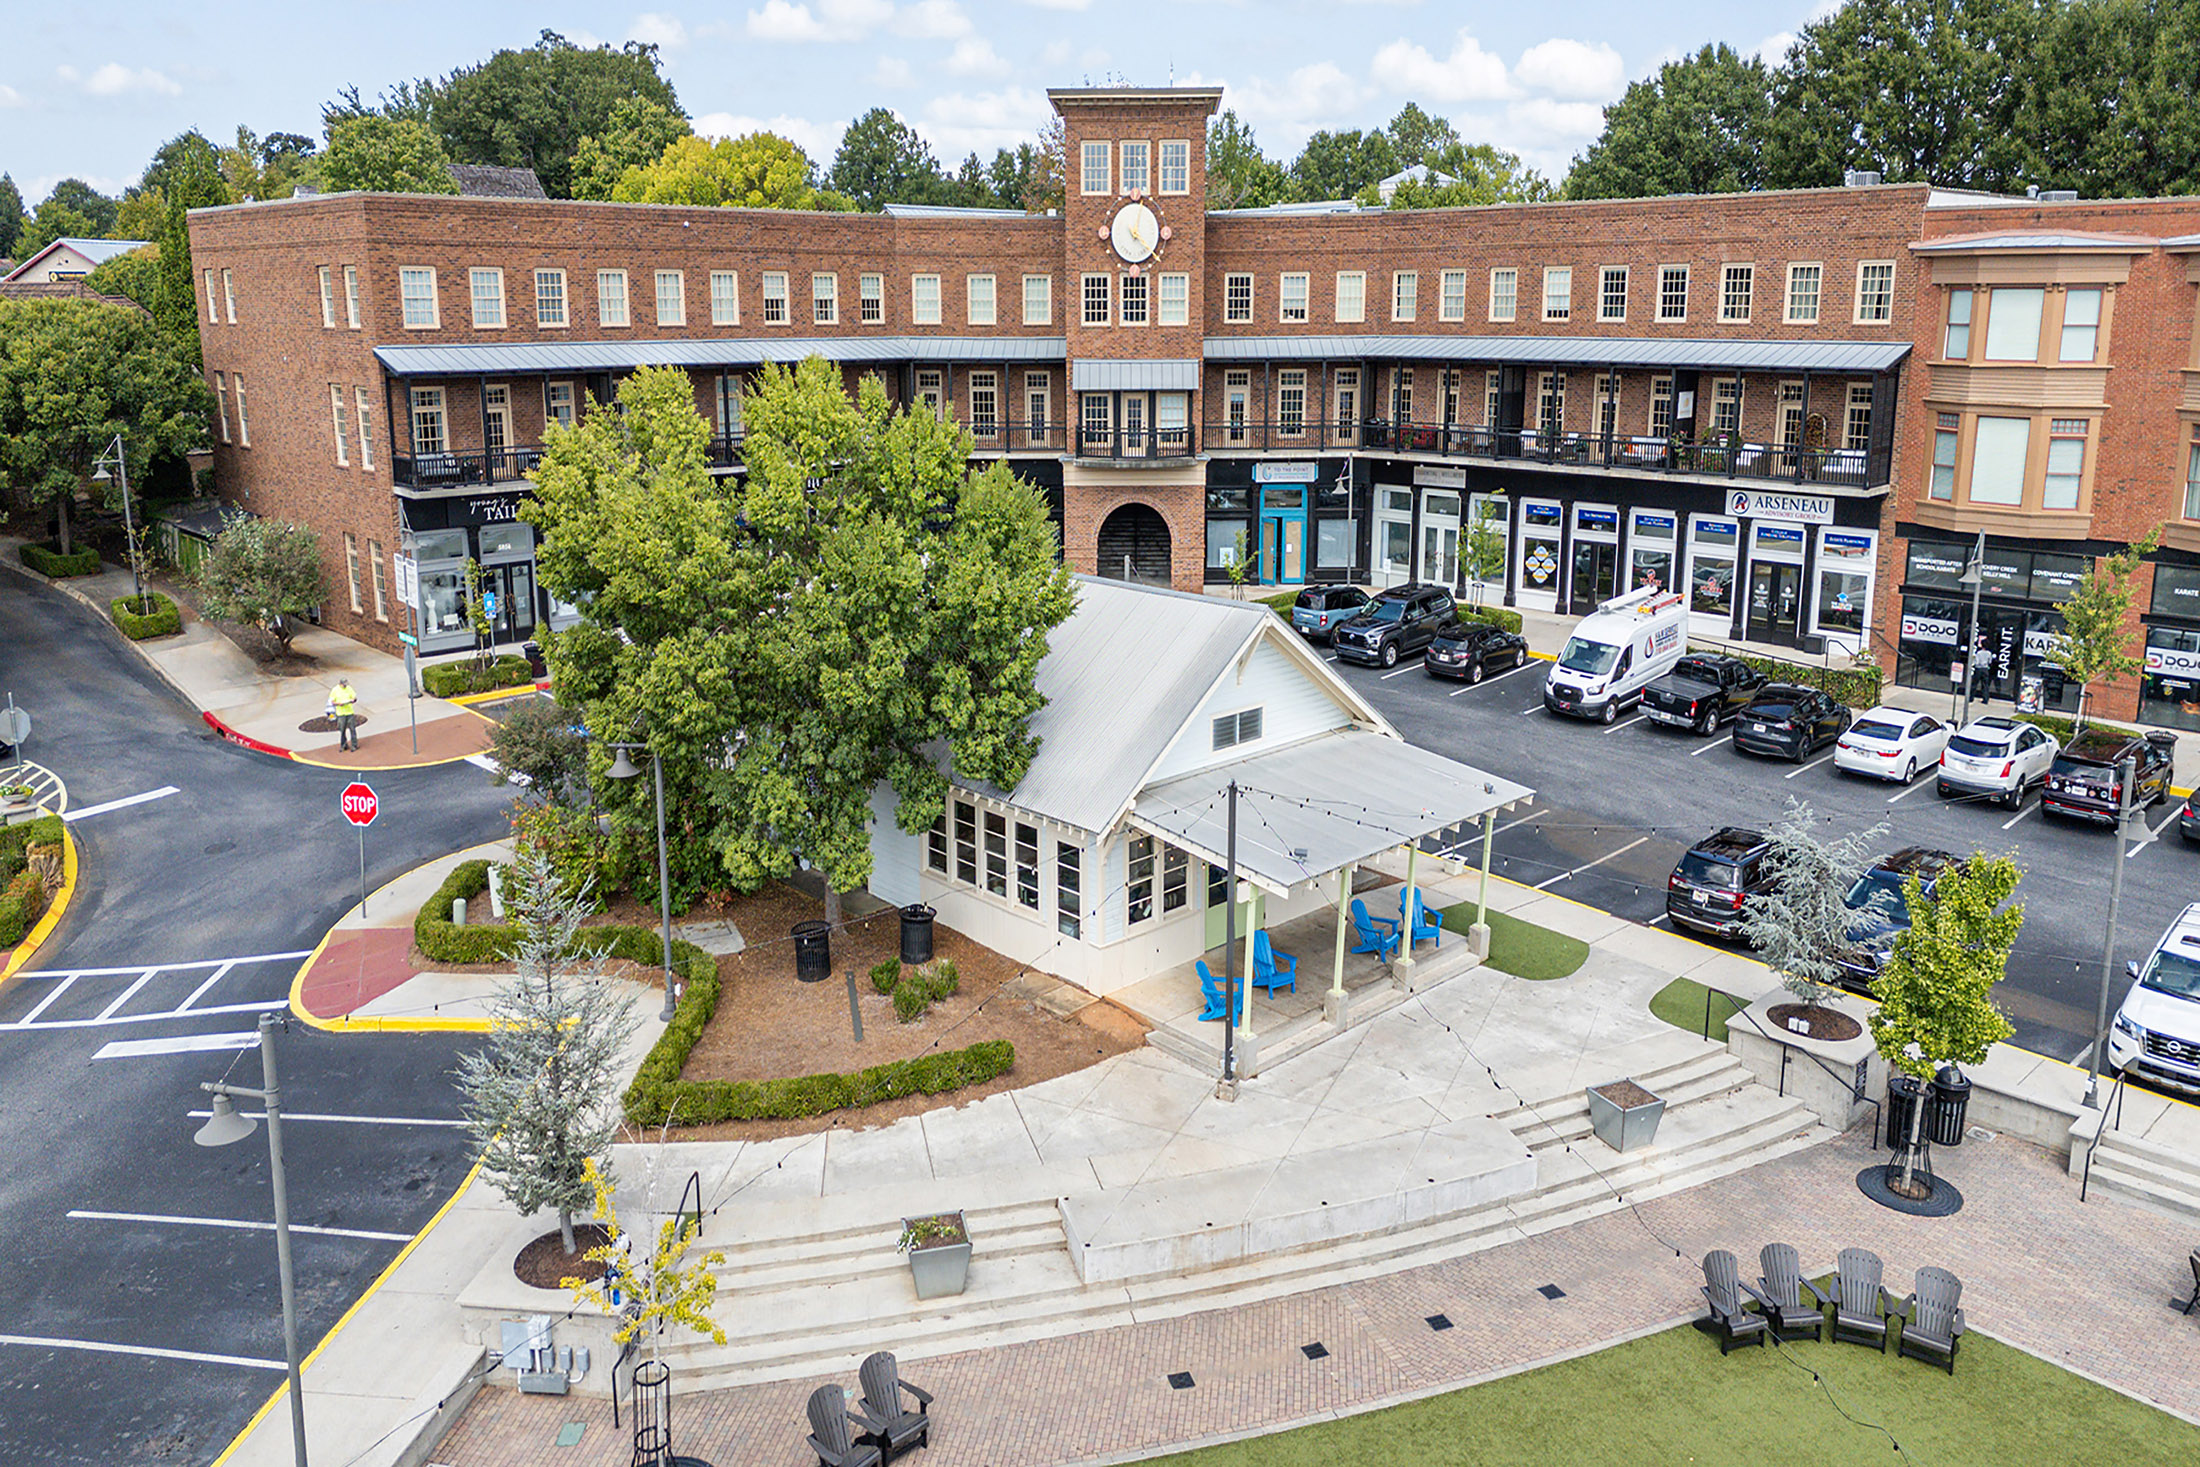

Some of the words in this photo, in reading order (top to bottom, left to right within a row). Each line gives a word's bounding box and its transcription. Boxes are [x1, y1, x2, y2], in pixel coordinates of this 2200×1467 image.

[483, 504, 517, 521] TAIL
[1754, 495, 1829, 514] ARSENEAU
[1763, 510, 1793, 519] ADVISORY
[1794, 512, 1817, 521] GROUP
[2174, 587, 2200, 597] KARATE
[1918, 621, 1957, 637] DOJO
[1997, 642, 2012, 679] EARN
[344, 795, 376, 813] STOP
